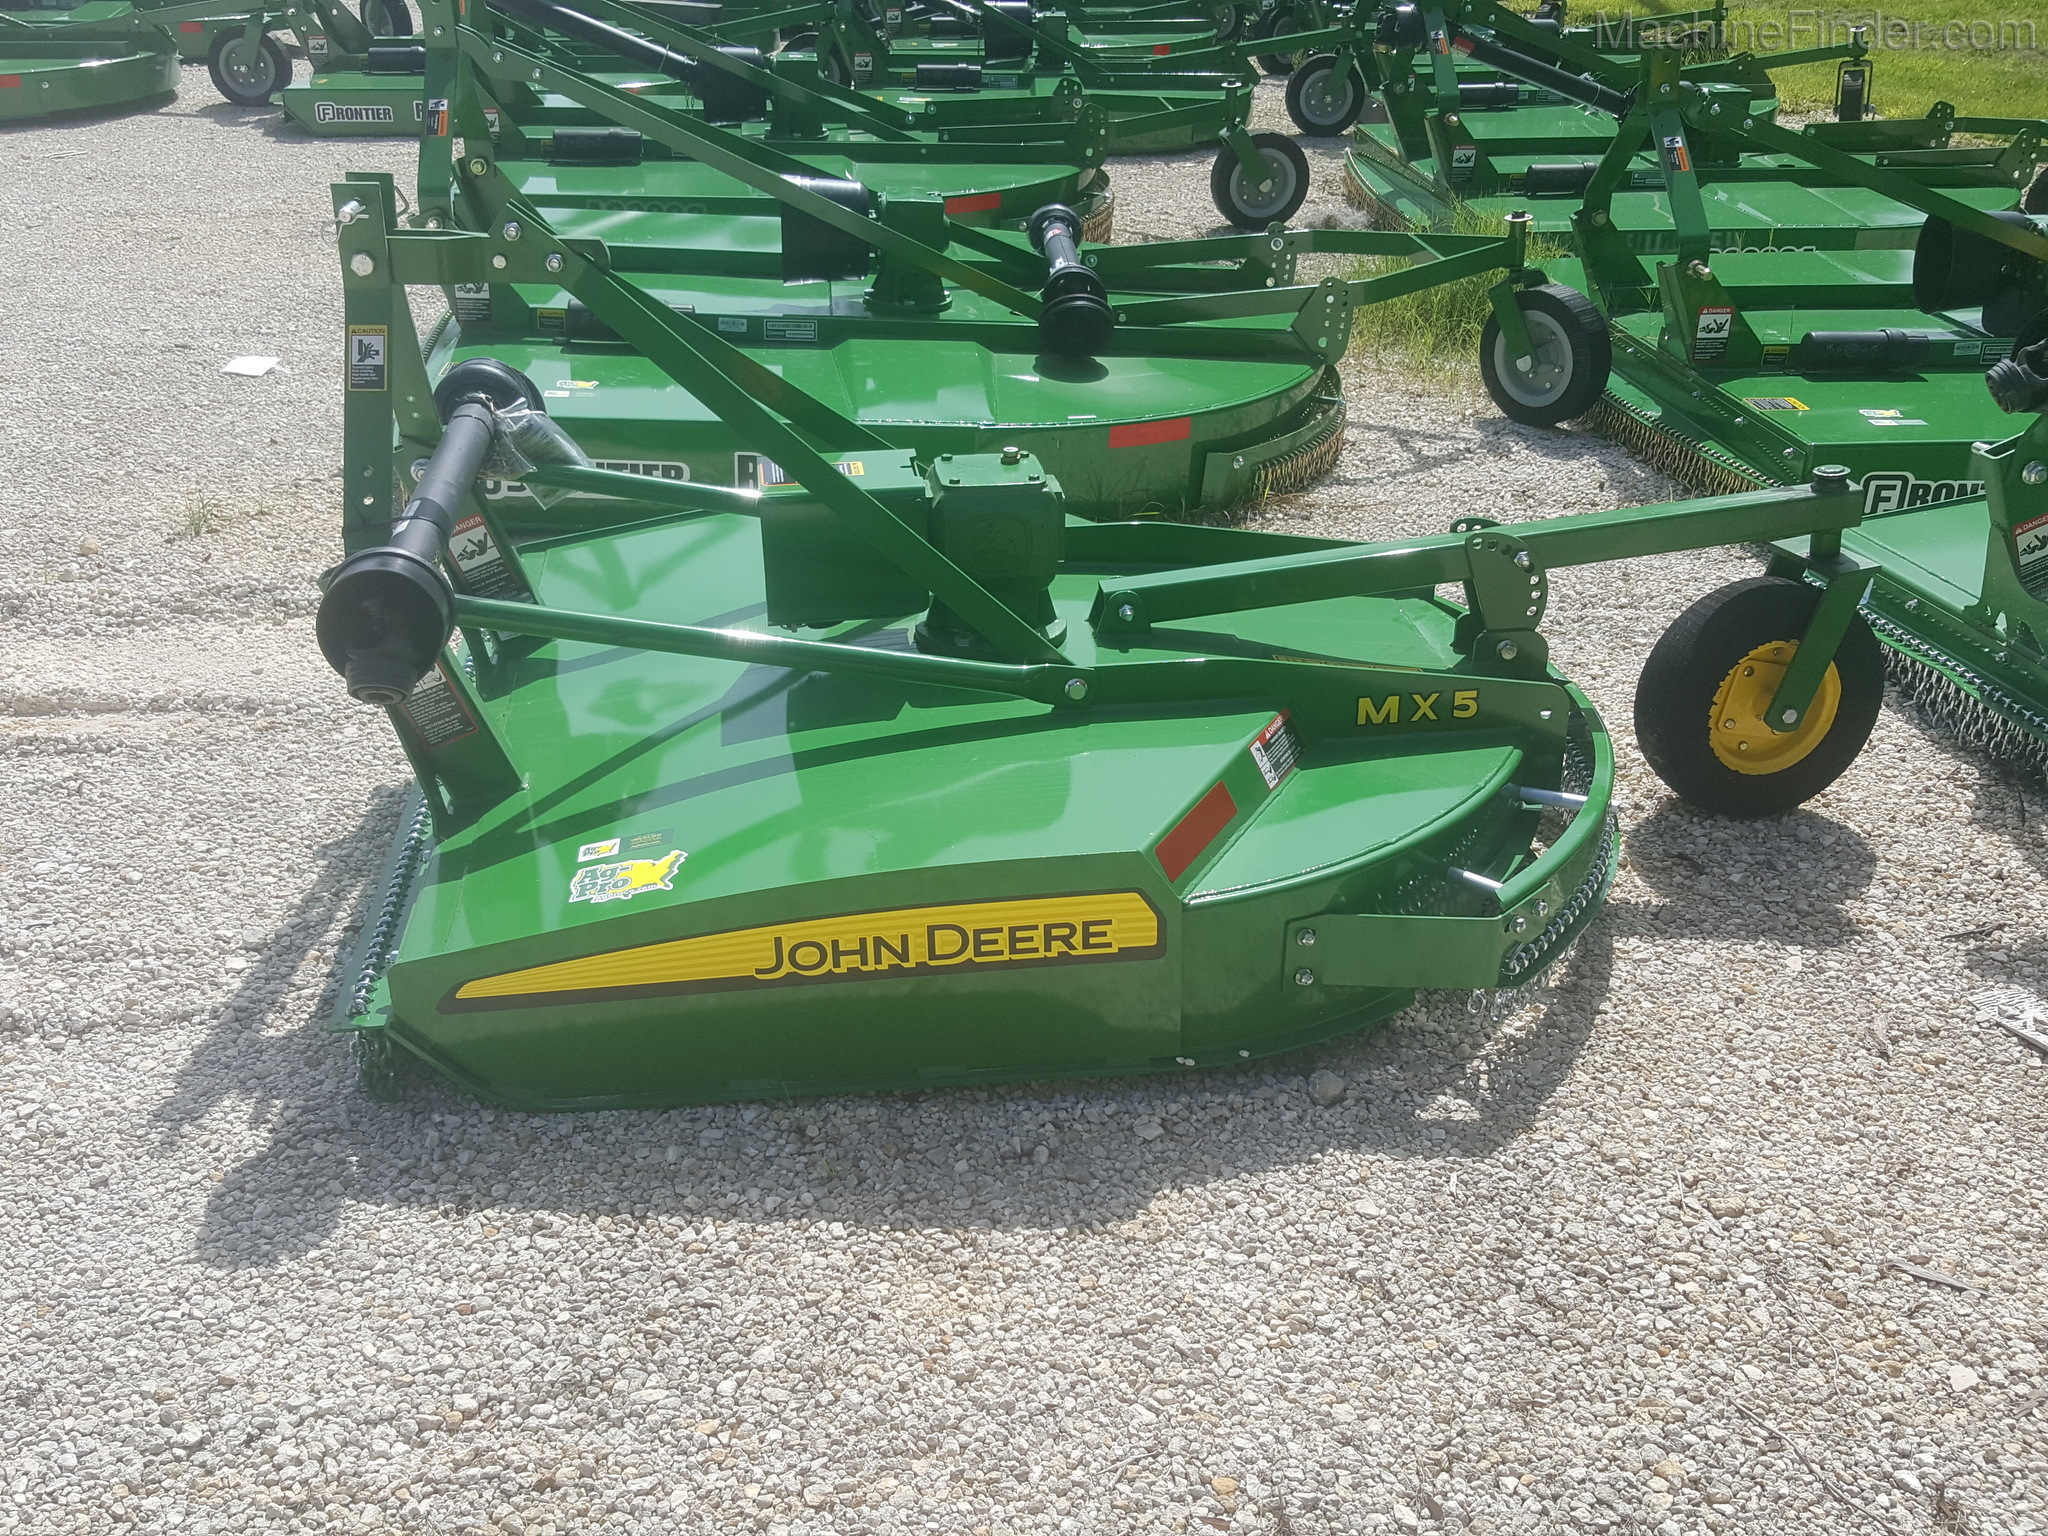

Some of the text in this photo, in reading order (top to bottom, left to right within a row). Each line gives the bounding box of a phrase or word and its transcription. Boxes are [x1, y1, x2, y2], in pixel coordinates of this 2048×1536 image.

[316, 103, 393, 122] FRONTIER
[577, 865, 632, 884] Ag-
[575, 878, 631, 899] Pro
[754, 918, 1114, 977] JOHN DEERE
